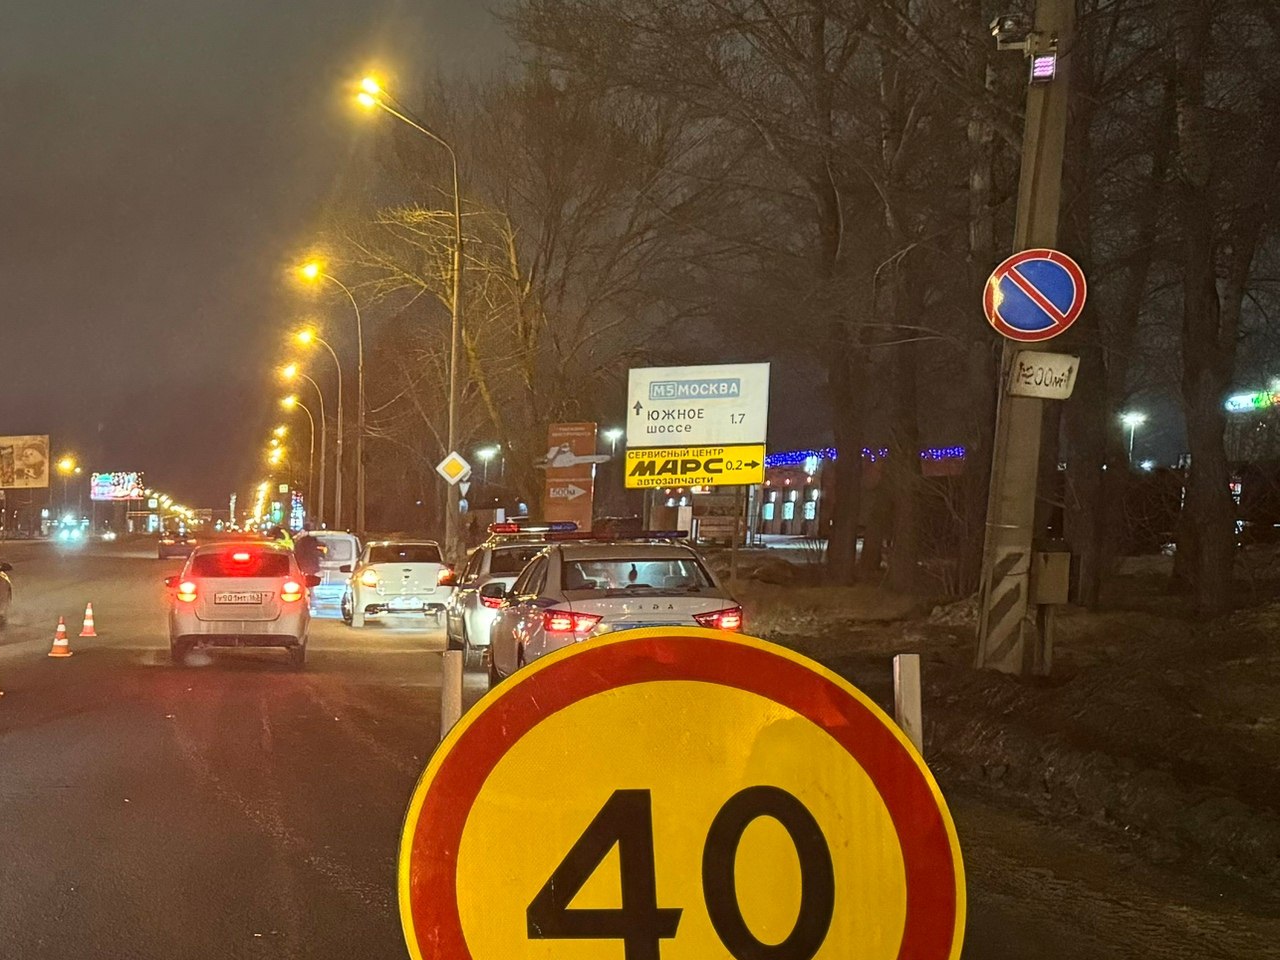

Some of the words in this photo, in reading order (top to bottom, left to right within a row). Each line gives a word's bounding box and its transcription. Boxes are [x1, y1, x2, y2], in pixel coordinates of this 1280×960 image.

[652, 385, 676, 397] М5
[678, 383, 739, 396] МОСКВА
[647, 408, 704, 421] ЮЖНОЕ
[730, 413, 745, 424] 1.7
[647, 424, 692, 434] шоссе
[628, 448, 690, 459] СЕРВИСНЫЙ
[692, 448, 724, 458] ЦЕНТР
[629, 458, 723, 477] МАРС
[725, 461, 743, 471] 0.2
[637, 476, 713, 487] автозапчасти
